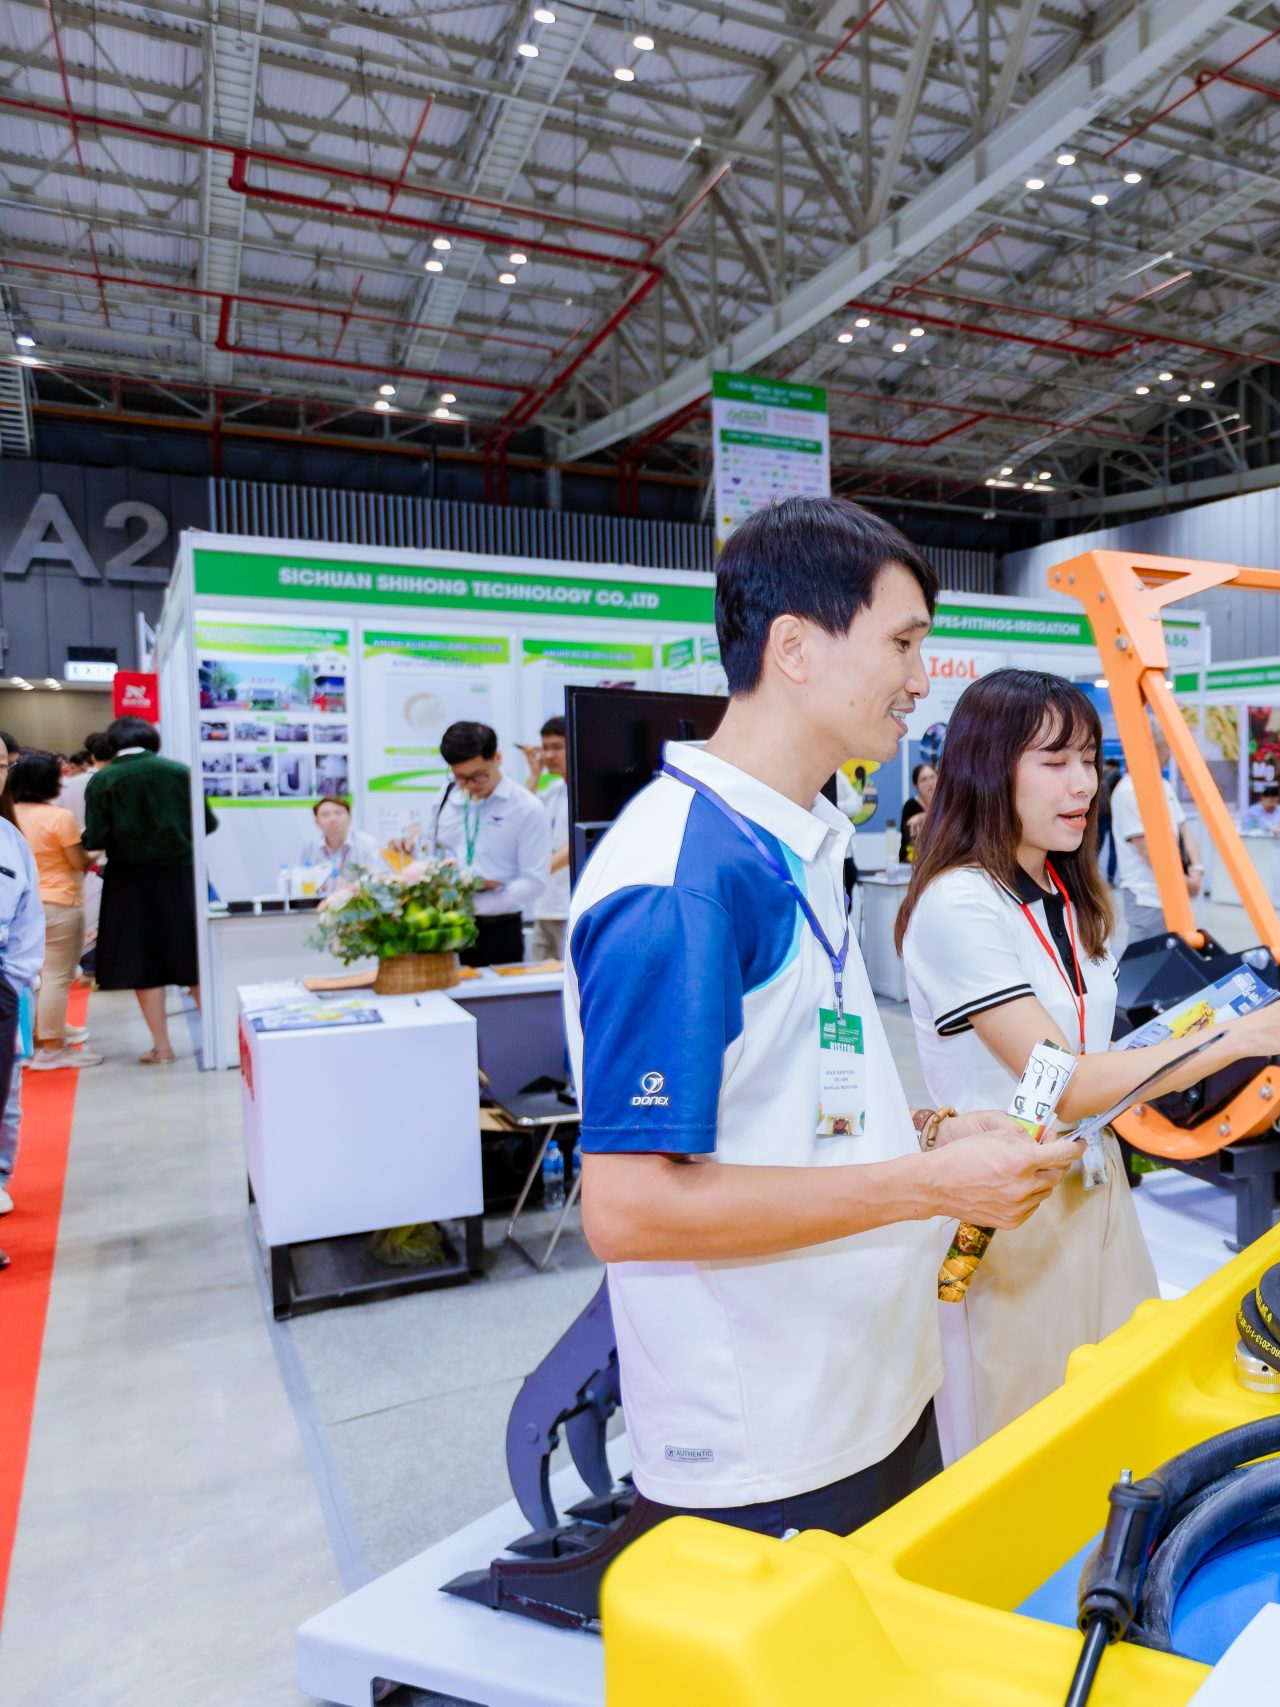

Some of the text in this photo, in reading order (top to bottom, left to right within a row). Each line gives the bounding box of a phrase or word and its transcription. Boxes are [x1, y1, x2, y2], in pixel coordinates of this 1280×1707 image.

[2, 493, 171, 583] A2
[279, 567, 660, 610] SICHUAN SHIHONG TECHNOLOGY CO.,LTD
[933, 615, 1081, 636] IPES-FITTINGS-IRRIGATION
[632, 1096, 669, 1106] DONEX
